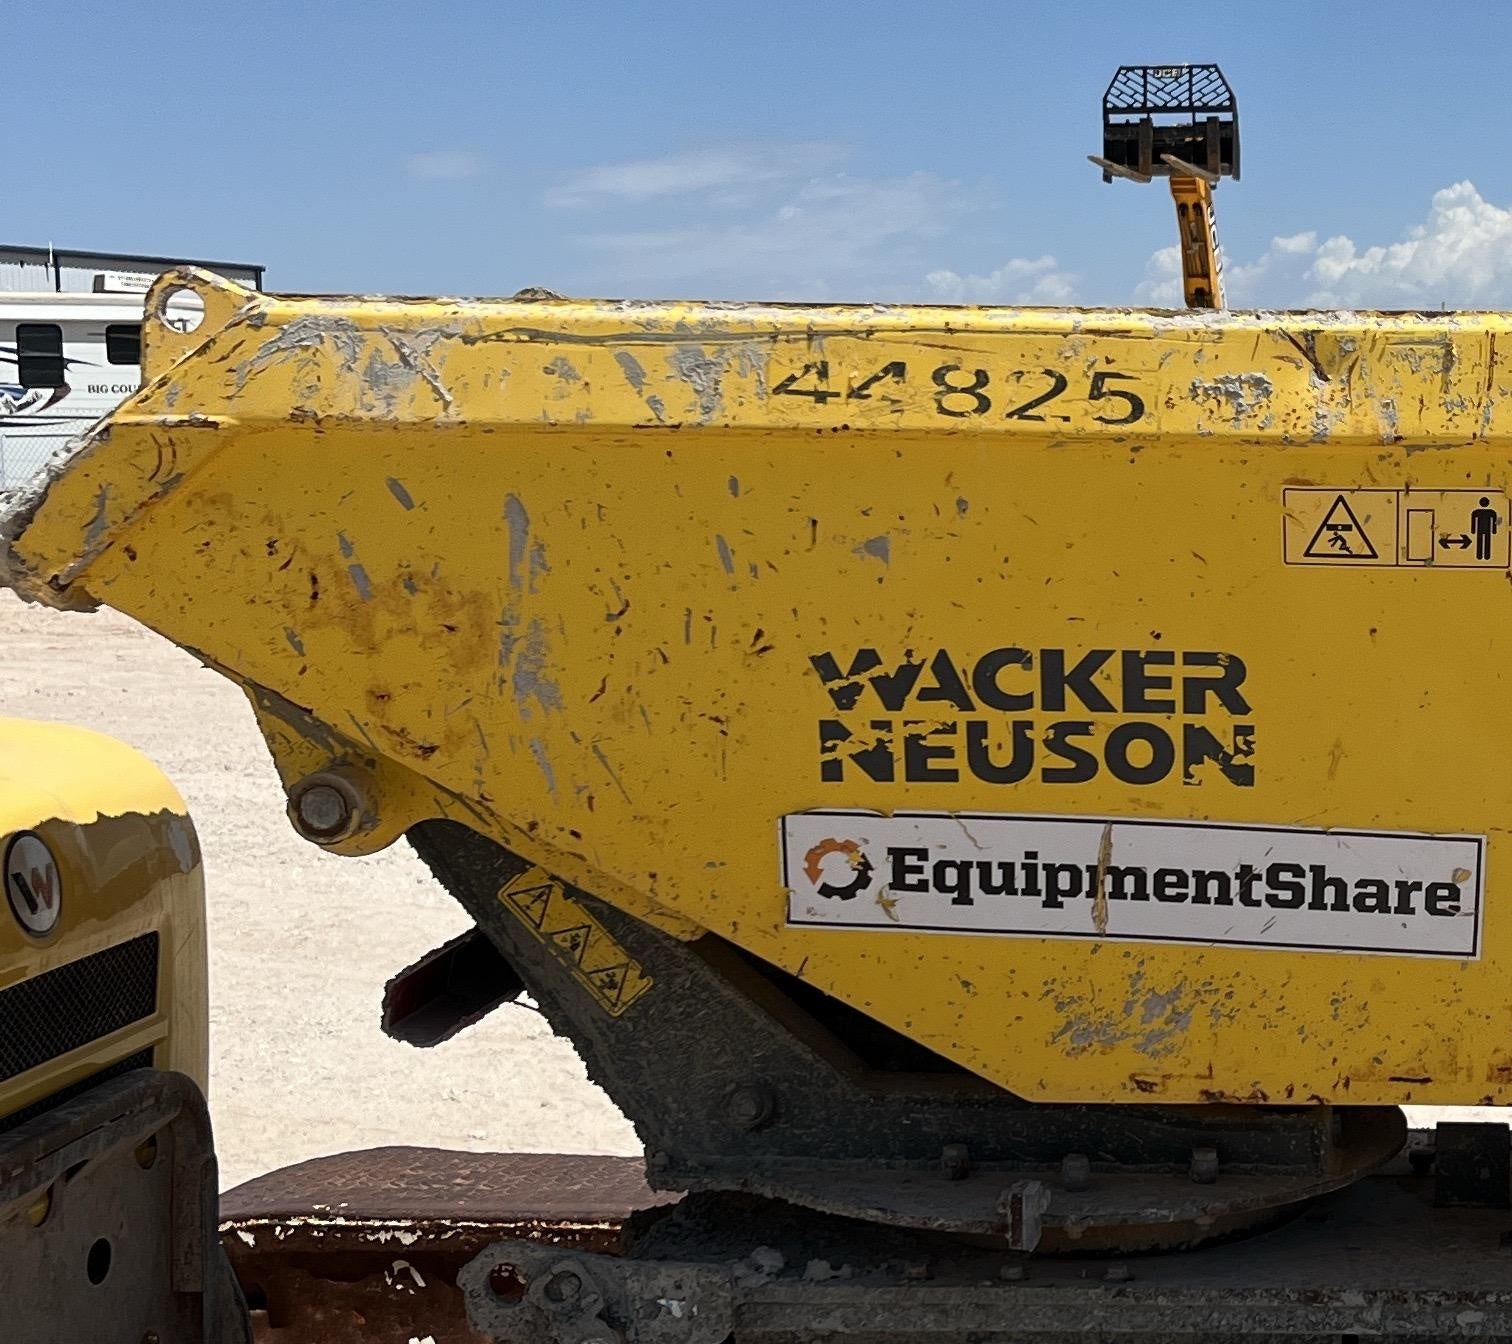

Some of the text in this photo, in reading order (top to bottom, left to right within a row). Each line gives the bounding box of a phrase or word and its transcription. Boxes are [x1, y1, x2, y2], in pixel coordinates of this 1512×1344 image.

[772, 360, 1145, 424] 44825
[808, 647, 1254, 716] WACKER
[818, 719, 1256, 787] NEUSON
[886, 846, 1463, 918] EquipmentShare
